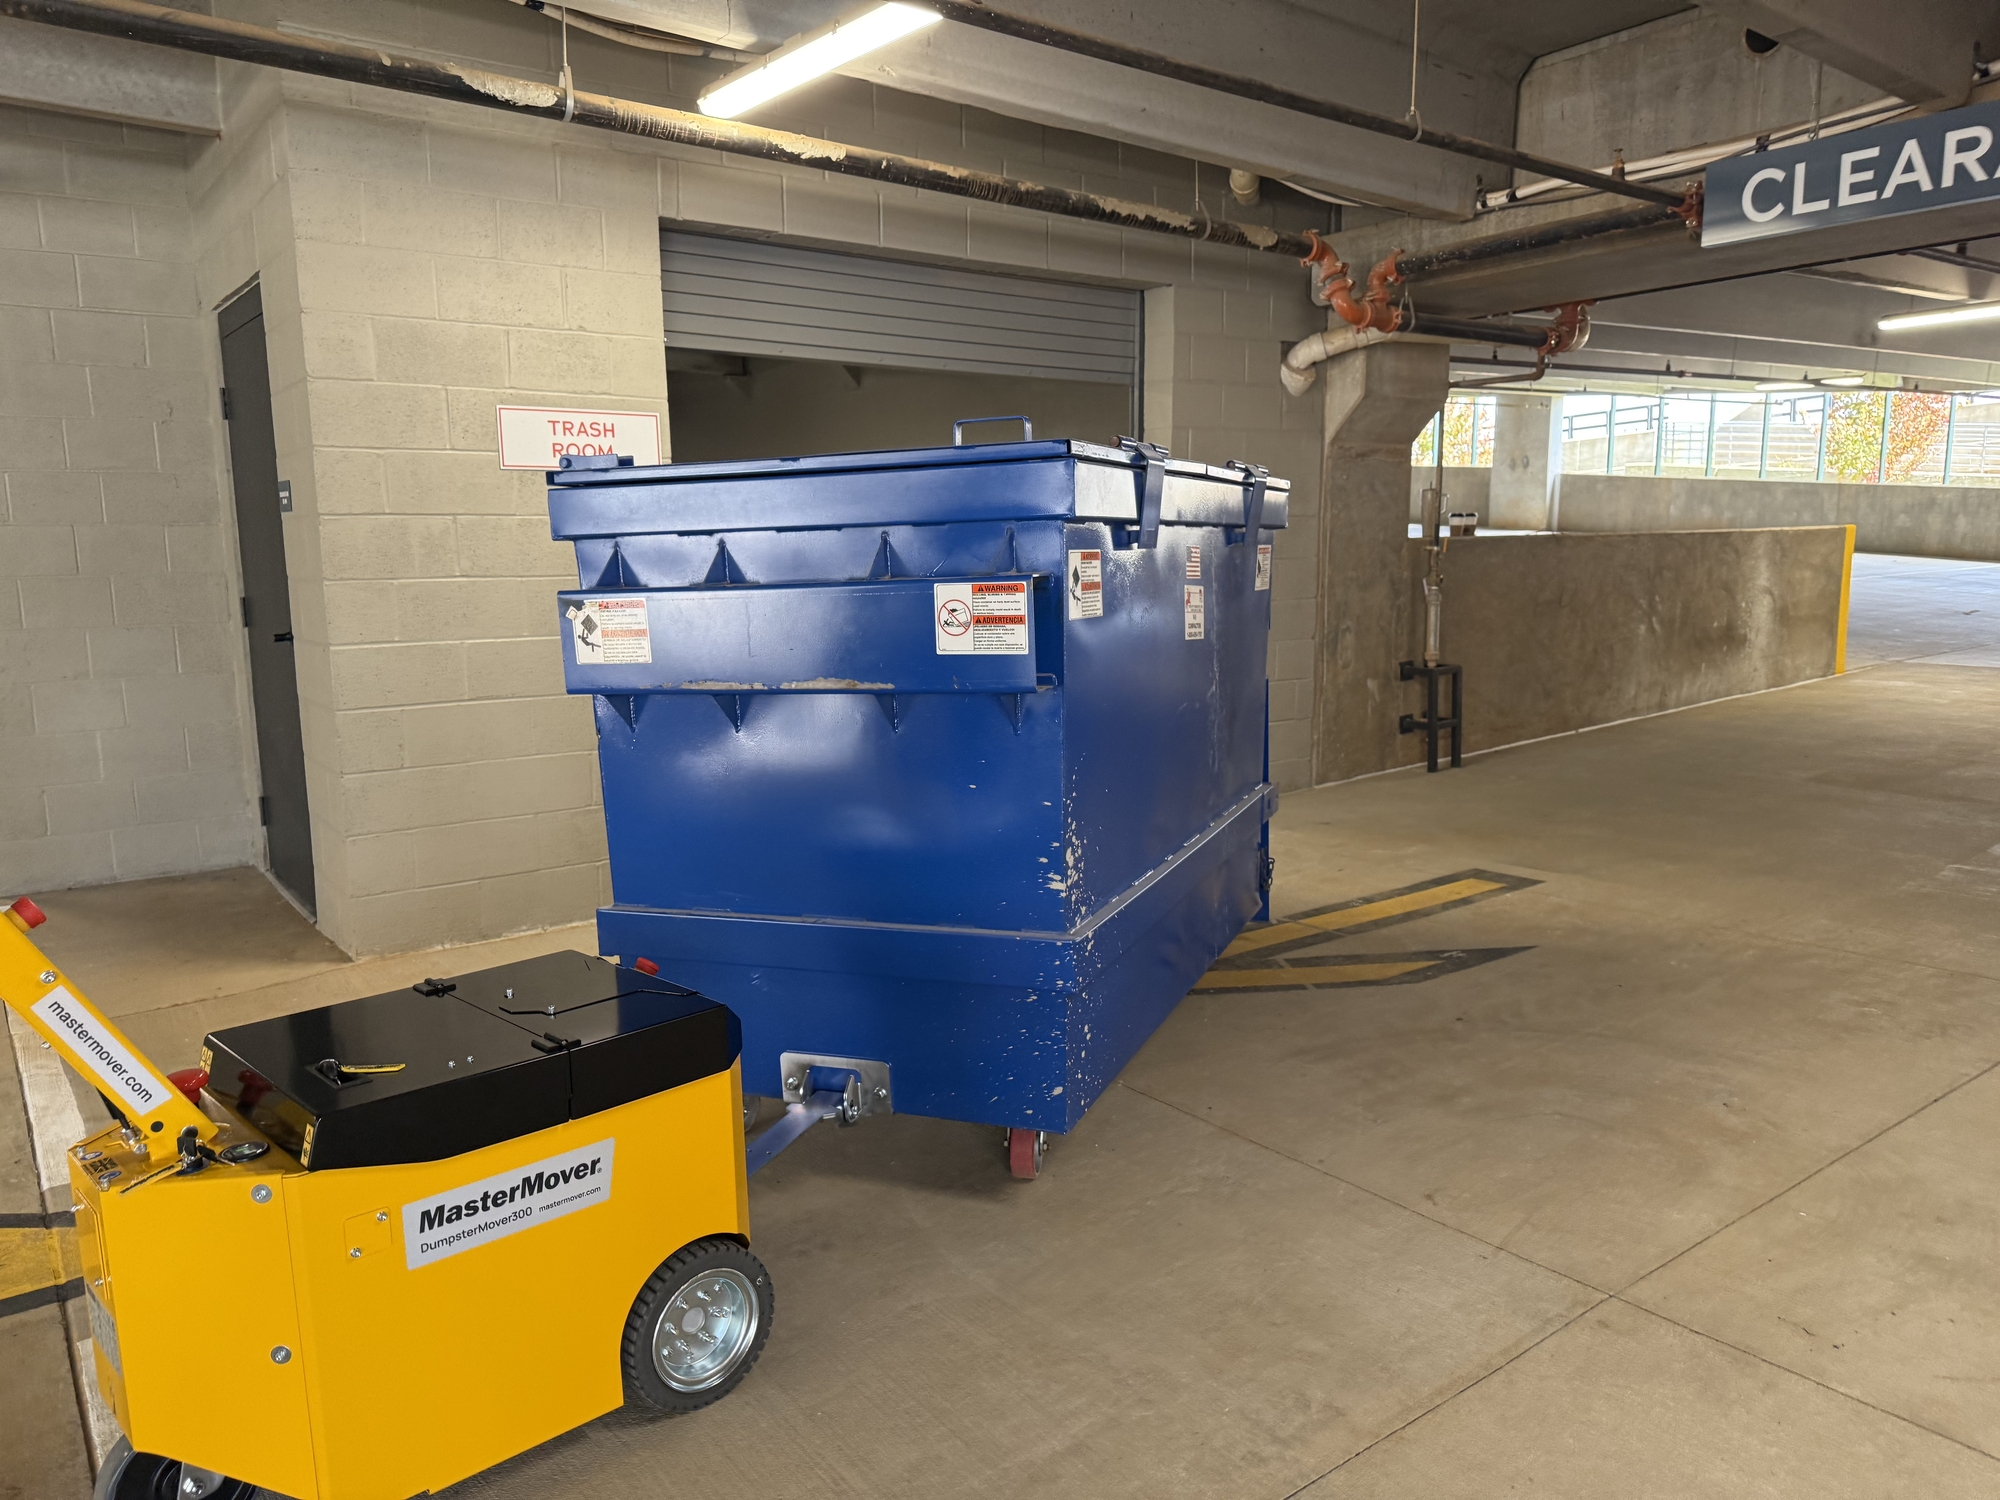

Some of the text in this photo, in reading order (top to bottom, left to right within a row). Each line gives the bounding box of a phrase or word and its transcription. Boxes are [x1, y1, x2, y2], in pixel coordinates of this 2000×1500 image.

[1741, 125, 2000, 223] CLEAR
[547, 420, 615, 438] TRASH
[552, 442, 613, 458] ROOM
[984, 584, 1018, 592] WARNING
[982, 616, 1023, 624] ADVERTENCIA
[48, 1000, 153, 1104] mastermover.com
[420, 1185, 602, 1254] DumpsterMover300 mastermover.com
